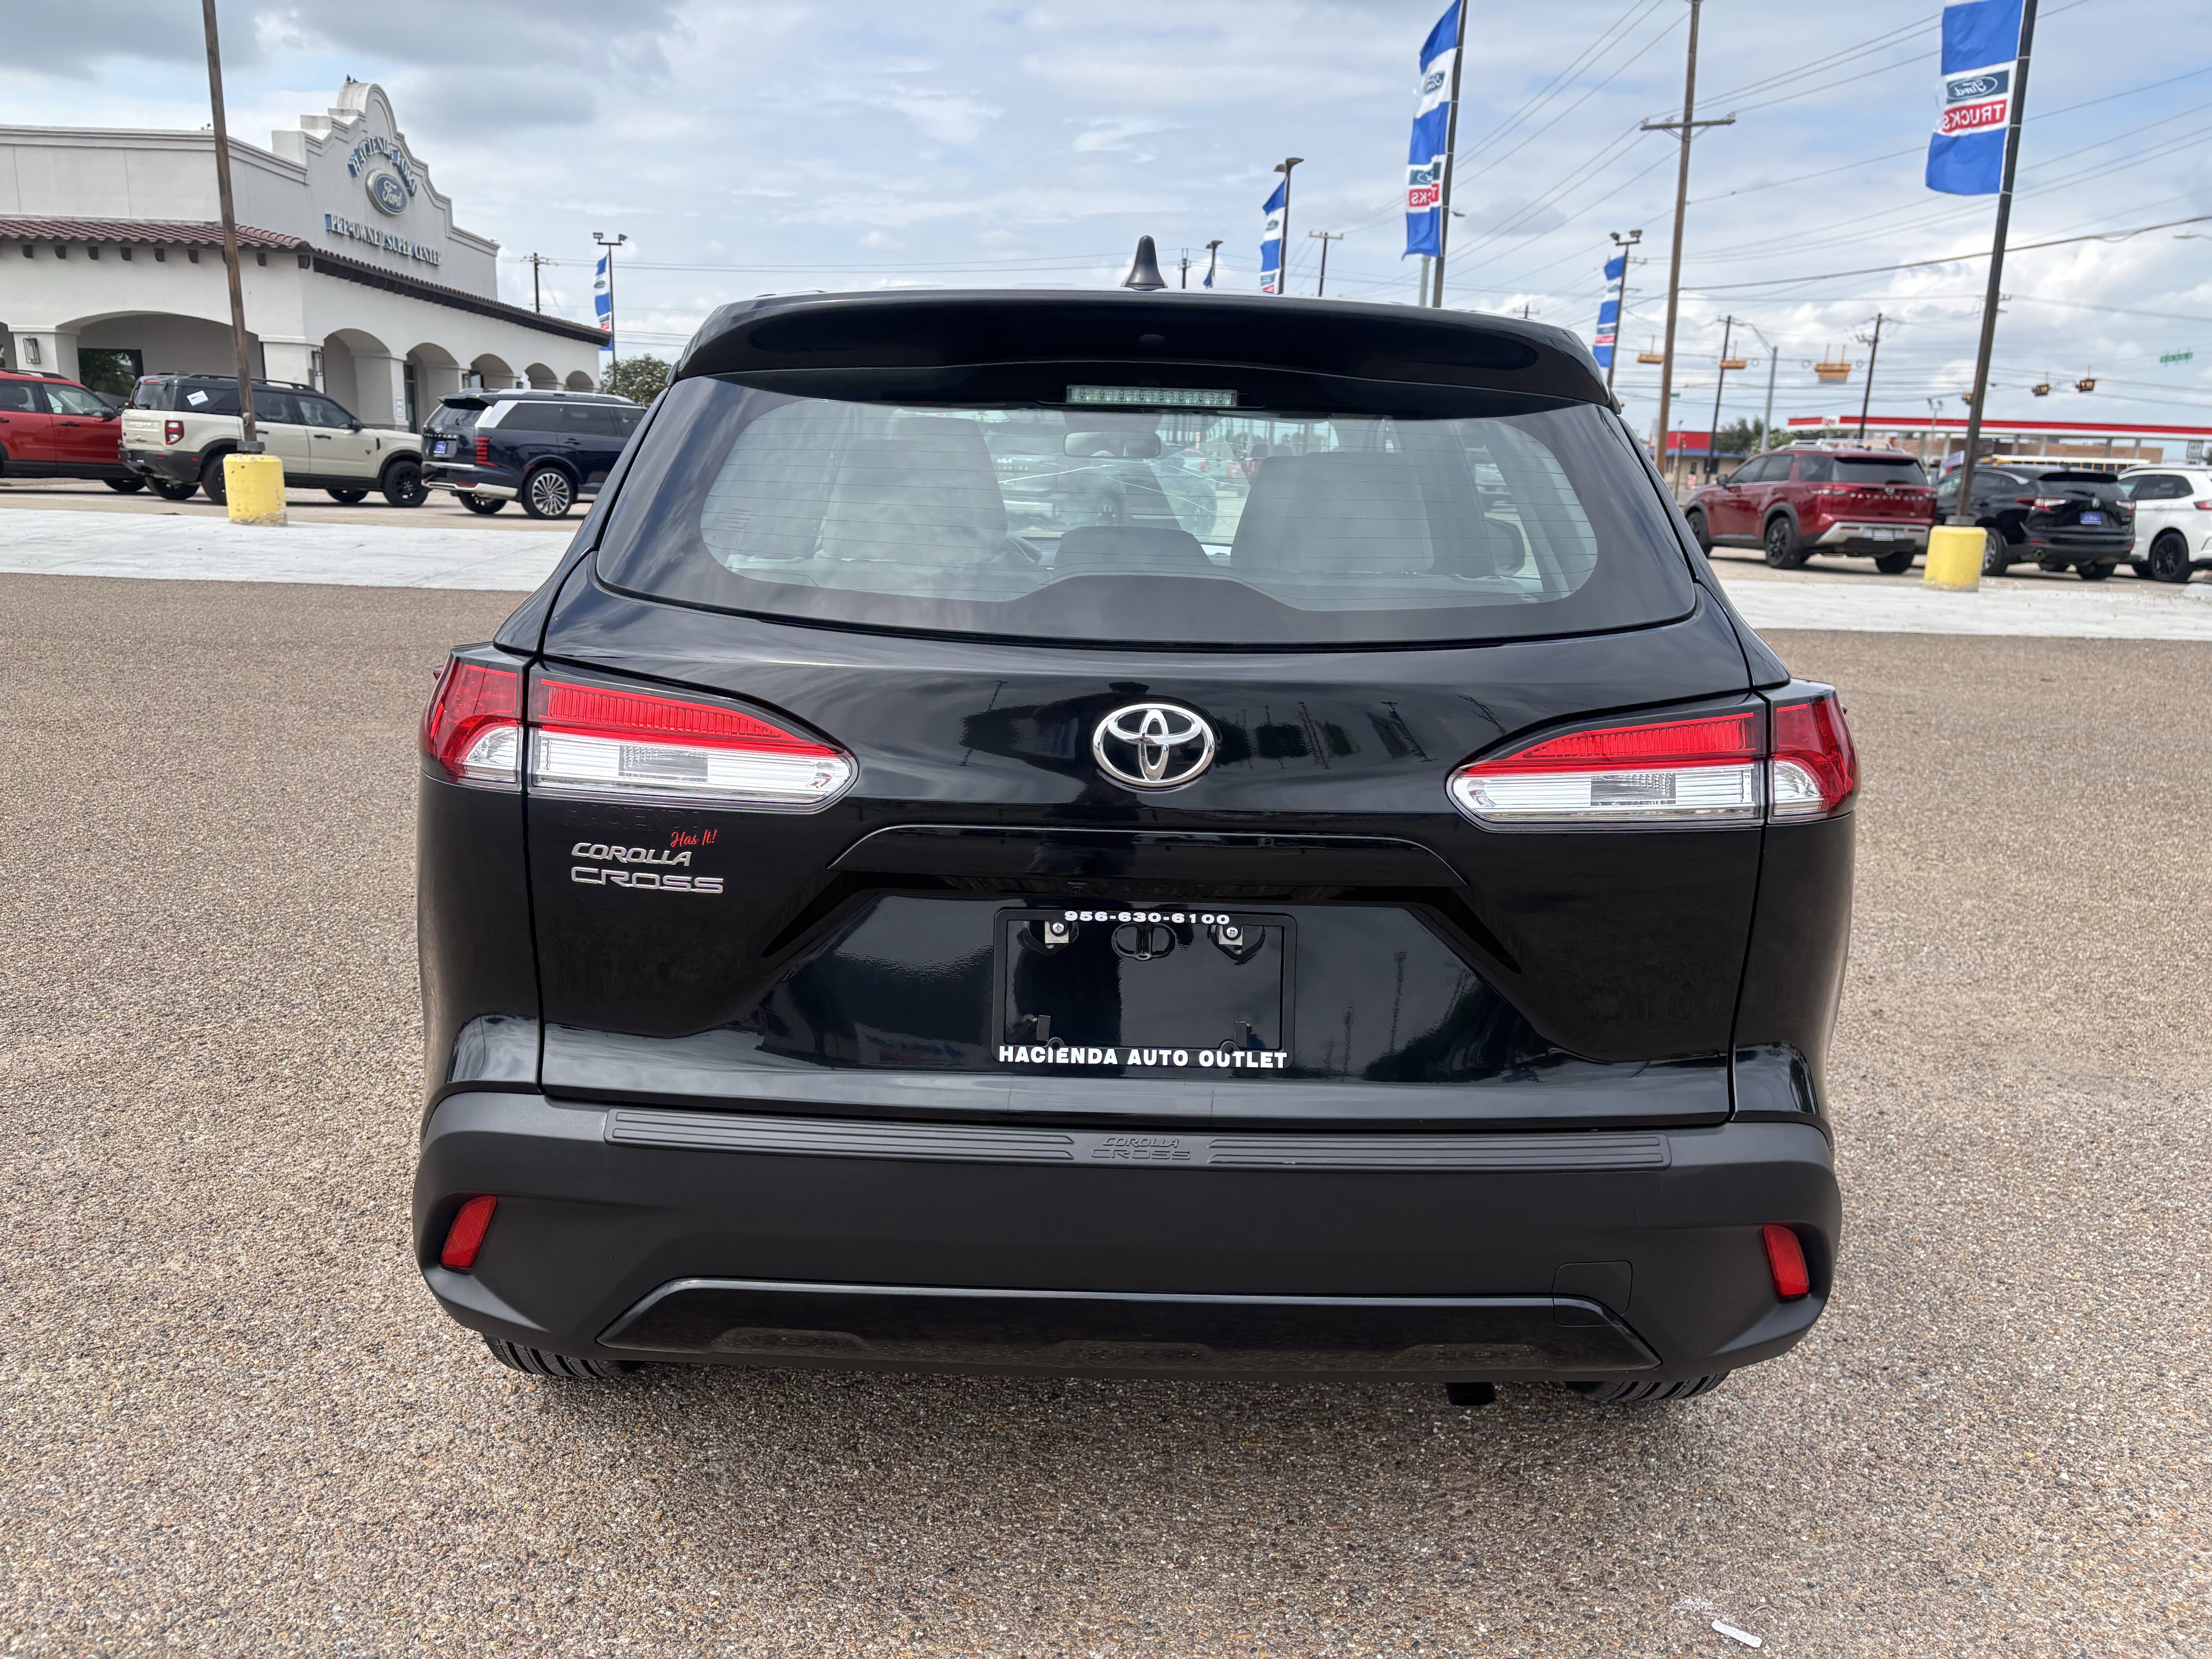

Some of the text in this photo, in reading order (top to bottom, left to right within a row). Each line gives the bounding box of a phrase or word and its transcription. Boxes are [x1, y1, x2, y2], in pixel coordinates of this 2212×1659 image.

[382, 180, 403, 207] Ford
[387, 234, 413, 256] SUPER
[670, 828, 718, 848] Has It!
[571, 842, 692, 867] COROLLA
[571, 866, 724, 894] CROSS
[1064, 910, 1230, 925] 956-630-6100
[999, 1045, 1288, 1068] HACIENDA AUTO OUTLET
[1103, 1137, 1179, 1148] COROLLA
[1091, 1149, 1190, 1160] CROSS
